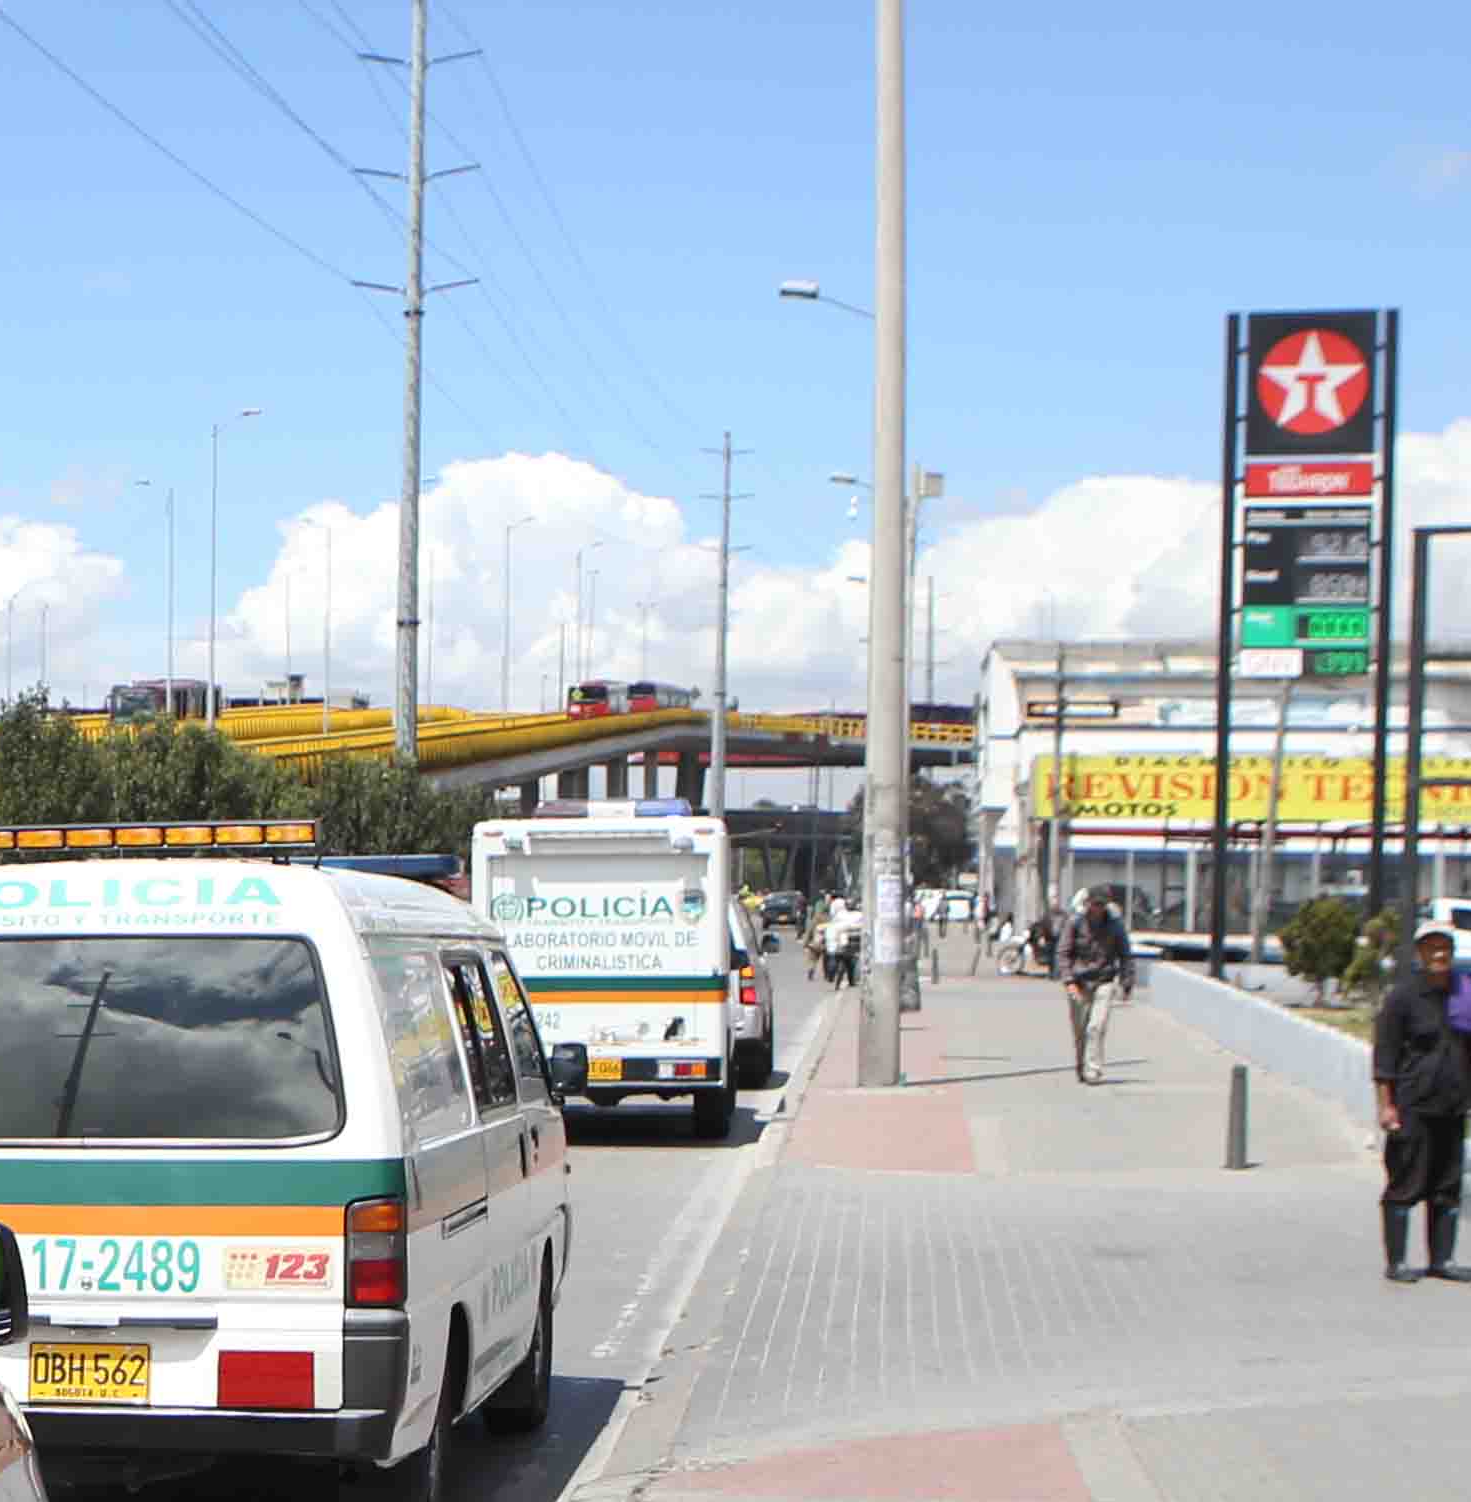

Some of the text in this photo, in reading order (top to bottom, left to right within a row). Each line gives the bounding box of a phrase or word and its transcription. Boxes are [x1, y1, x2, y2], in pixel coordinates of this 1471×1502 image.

[73, 912, 87, 927] Y
[99, 911, 284, 928] TRANSPORTE
[674, 929, 699, 947] DE
[32, 1238, 201, 1293] 17-2489
[264, 1252, 330, 1280] 123
